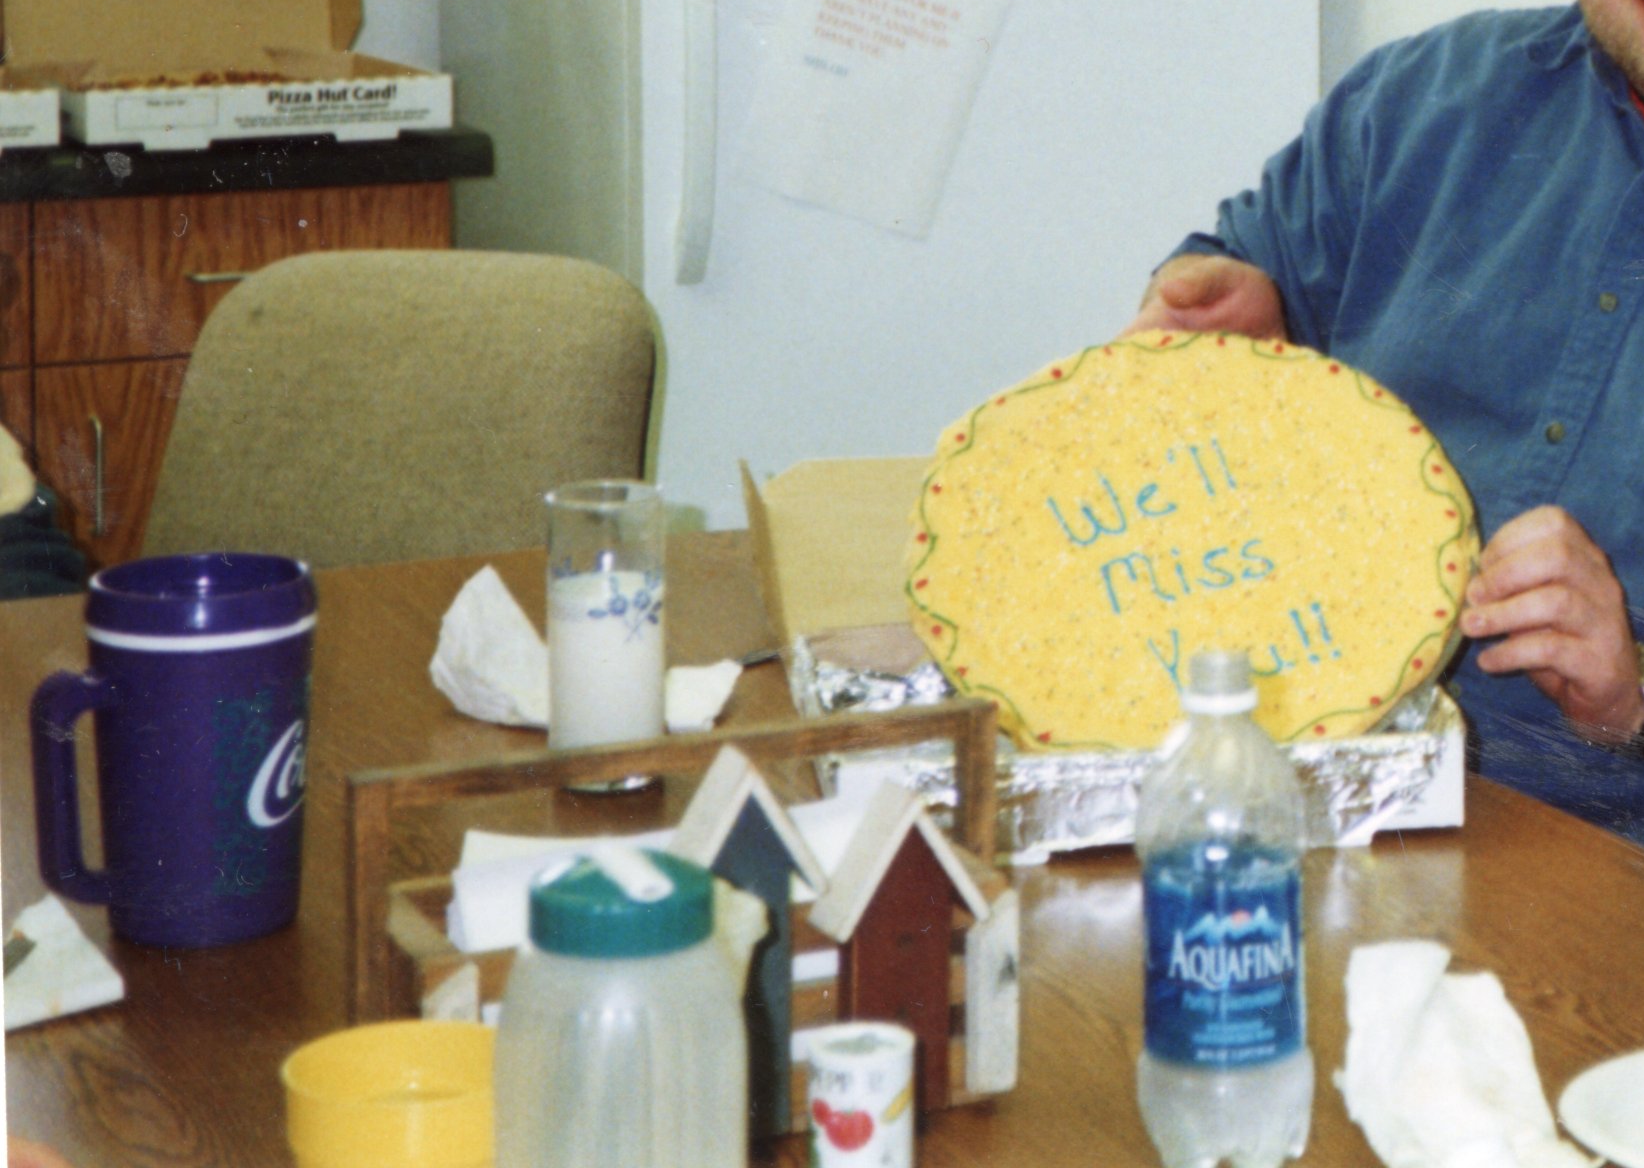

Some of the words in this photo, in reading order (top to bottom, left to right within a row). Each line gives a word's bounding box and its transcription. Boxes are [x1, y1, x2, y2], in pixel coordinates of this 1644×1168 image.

[268, 89, 312, 105] Pizza
[318, 88, 348, 102] Hut
[353, 84, 397, 101] Card!
[1045, 436, 1238, 547] We'll
[1147, 602, 1342, 695] Yu!!
[1168, 921, 1294, 991] AQUAFINA
